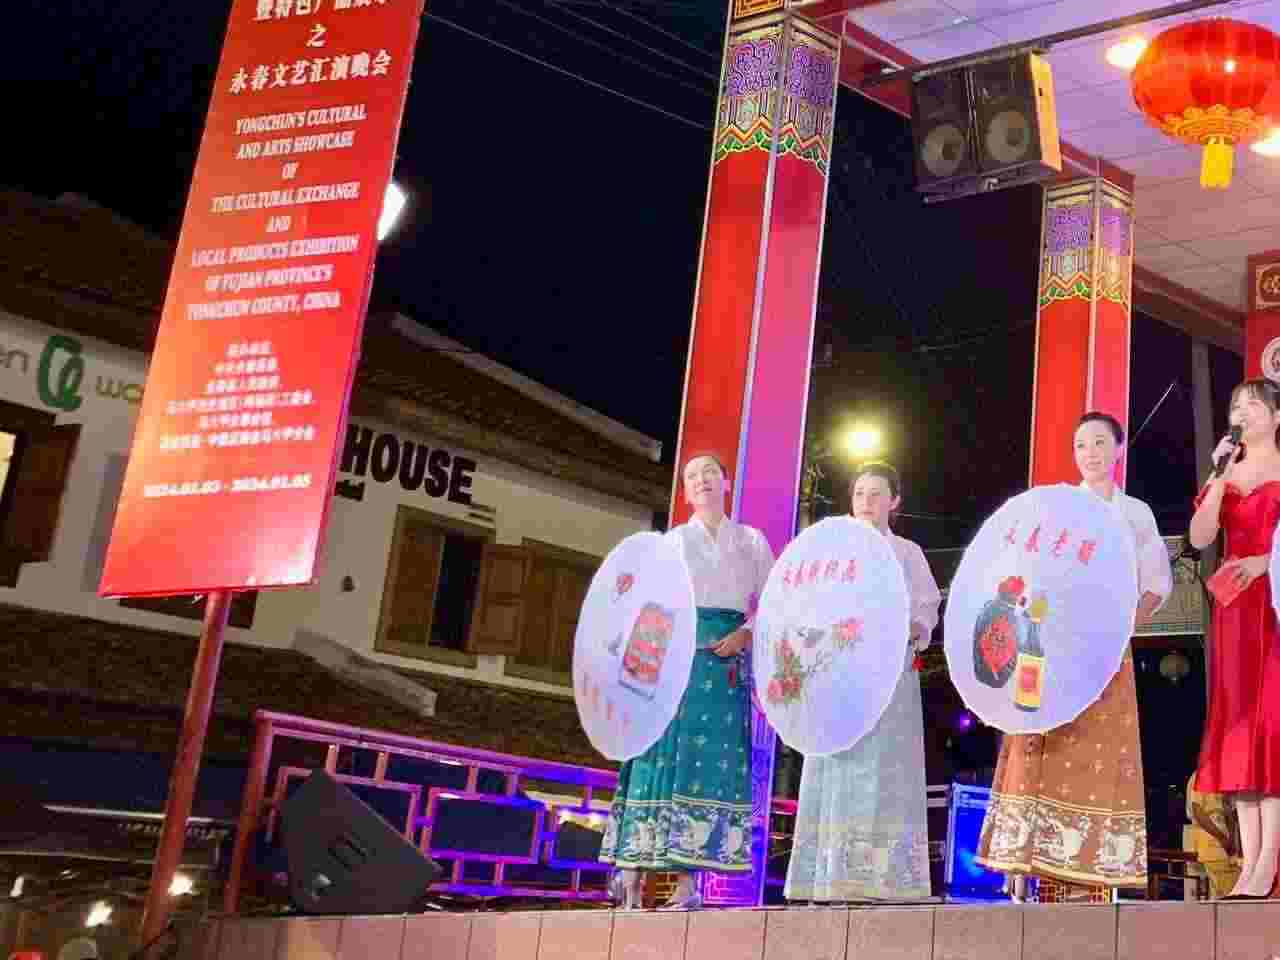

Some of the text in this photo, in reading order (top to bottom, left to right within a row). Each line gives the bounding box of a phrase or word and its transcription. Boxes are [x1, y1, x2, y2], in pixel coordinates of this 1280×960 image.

[306, 23, 328, 48] 之
[307, 104, 368, 127] CULTURAL
[236, 141, 261, 160] AND
[340, 423, 477, 505] HOUSE
